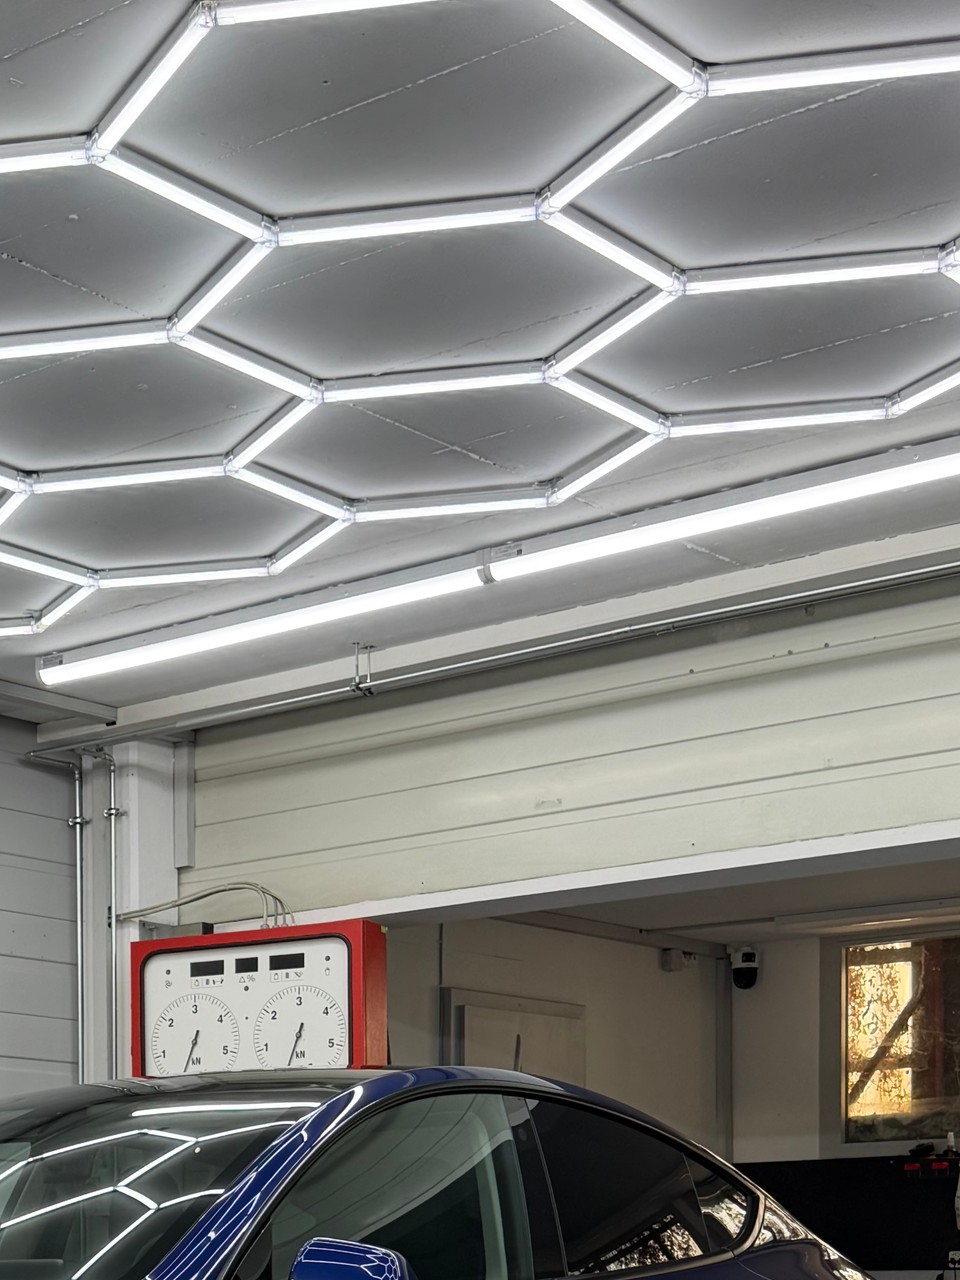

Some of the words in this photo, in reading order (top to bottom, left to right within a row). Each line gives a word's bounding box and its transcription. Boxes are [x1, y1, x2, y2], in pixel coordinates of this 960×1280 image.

[295, 996, 303, 1007] 3
[191, 1004, 199, 1015] 3
[270, 1010, 278, 1020] 2
[322, 1007, 330, 1017] 4
[167, 1018, 175, 1028] 2
[216, 1014, 224, 1024] 4
[263, 1042, 269, 1053] 1
[327, 1038, 335, 1049] 5
[222, 1045, 229, 1055] 5
[295, 1049, 306, 1060] kN
[191, 1056, 202, 1067] kN
